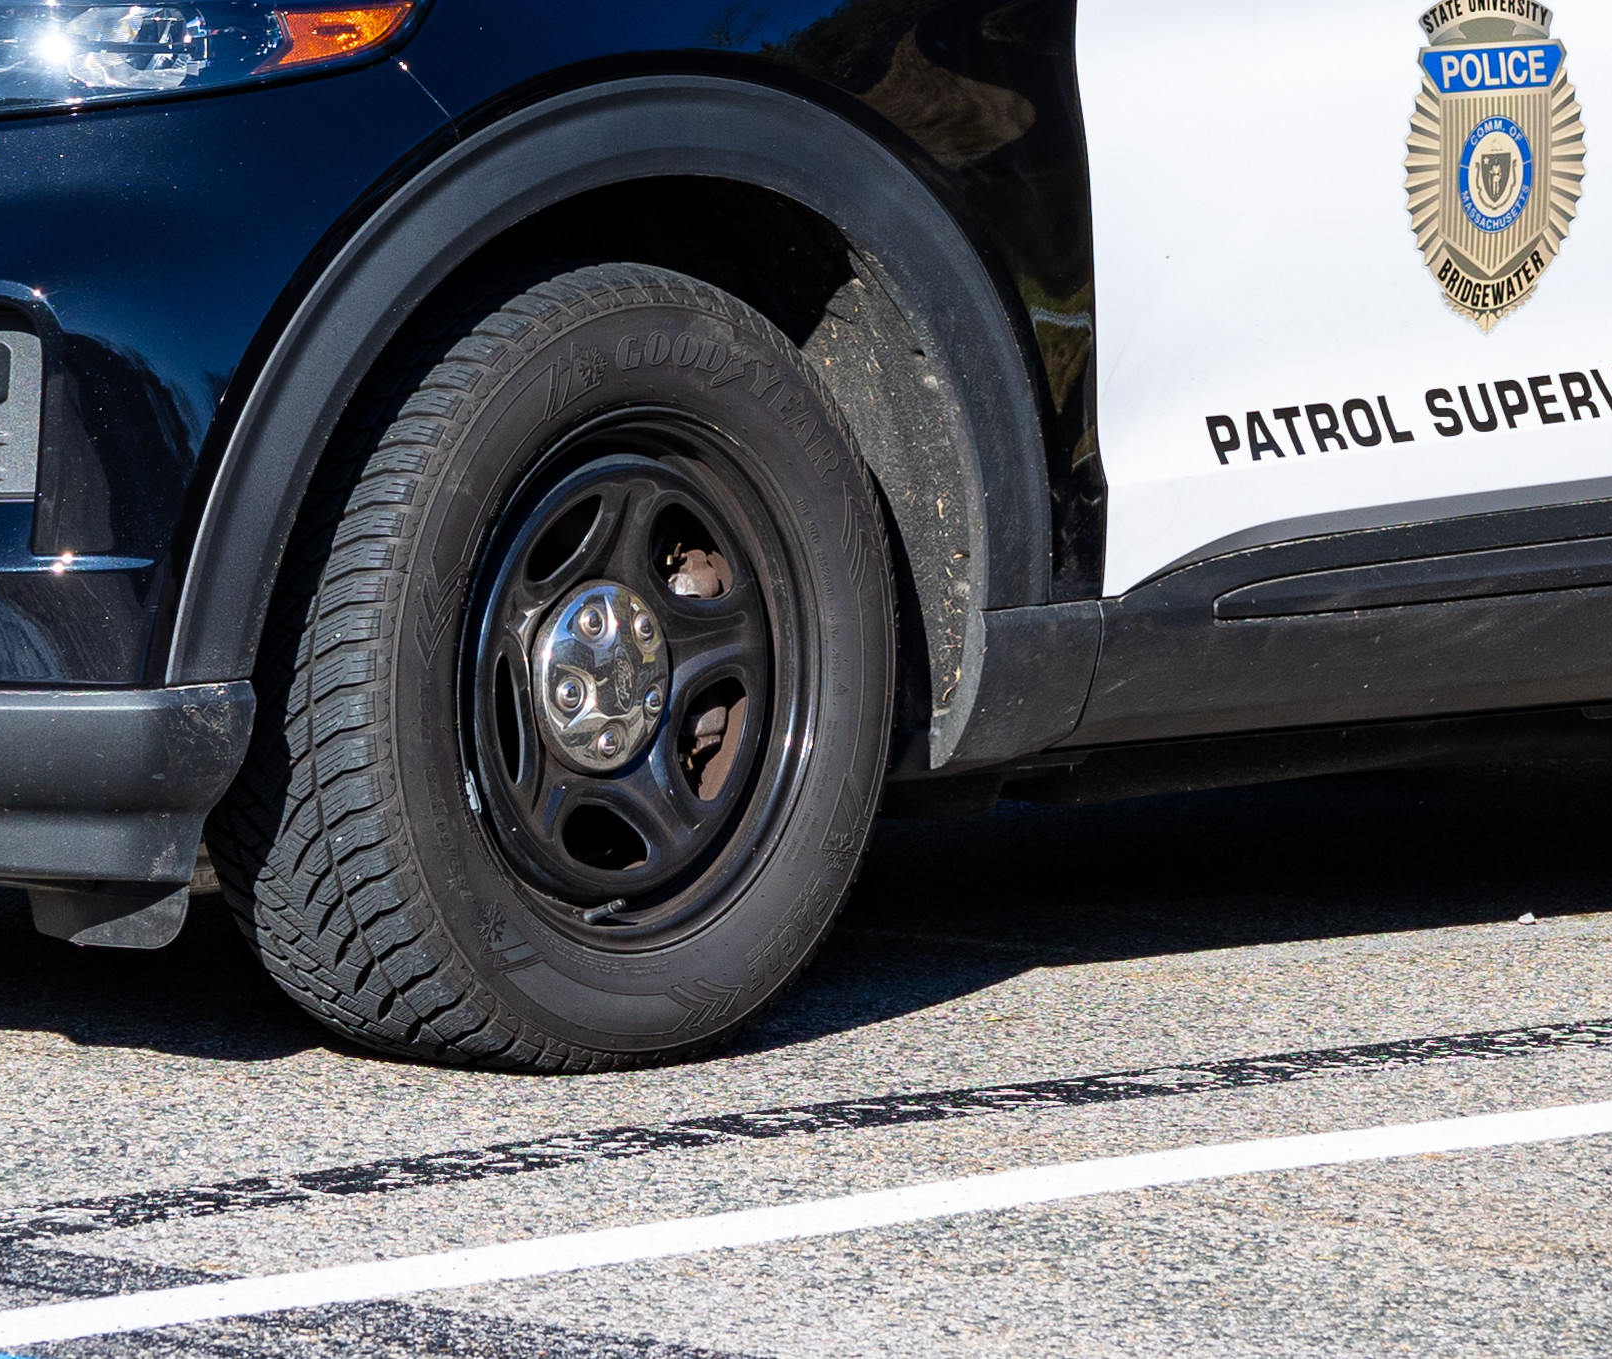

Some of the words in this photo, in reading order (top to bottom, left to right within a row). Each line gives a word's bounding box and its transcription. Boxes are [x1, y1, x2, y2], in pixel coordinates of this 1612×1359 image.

[1441, 50, 1547, 89] POLICE
[1470, 120, 1505, 146] COMM.
[1509, 126, 1523, 141] OF
[1462, 185, 1529, 230] MASSACHUSETTS
[1437, 250, 1545, 307] BRIDGEWATER
[1205, 395, 1415, 465] PATROL
